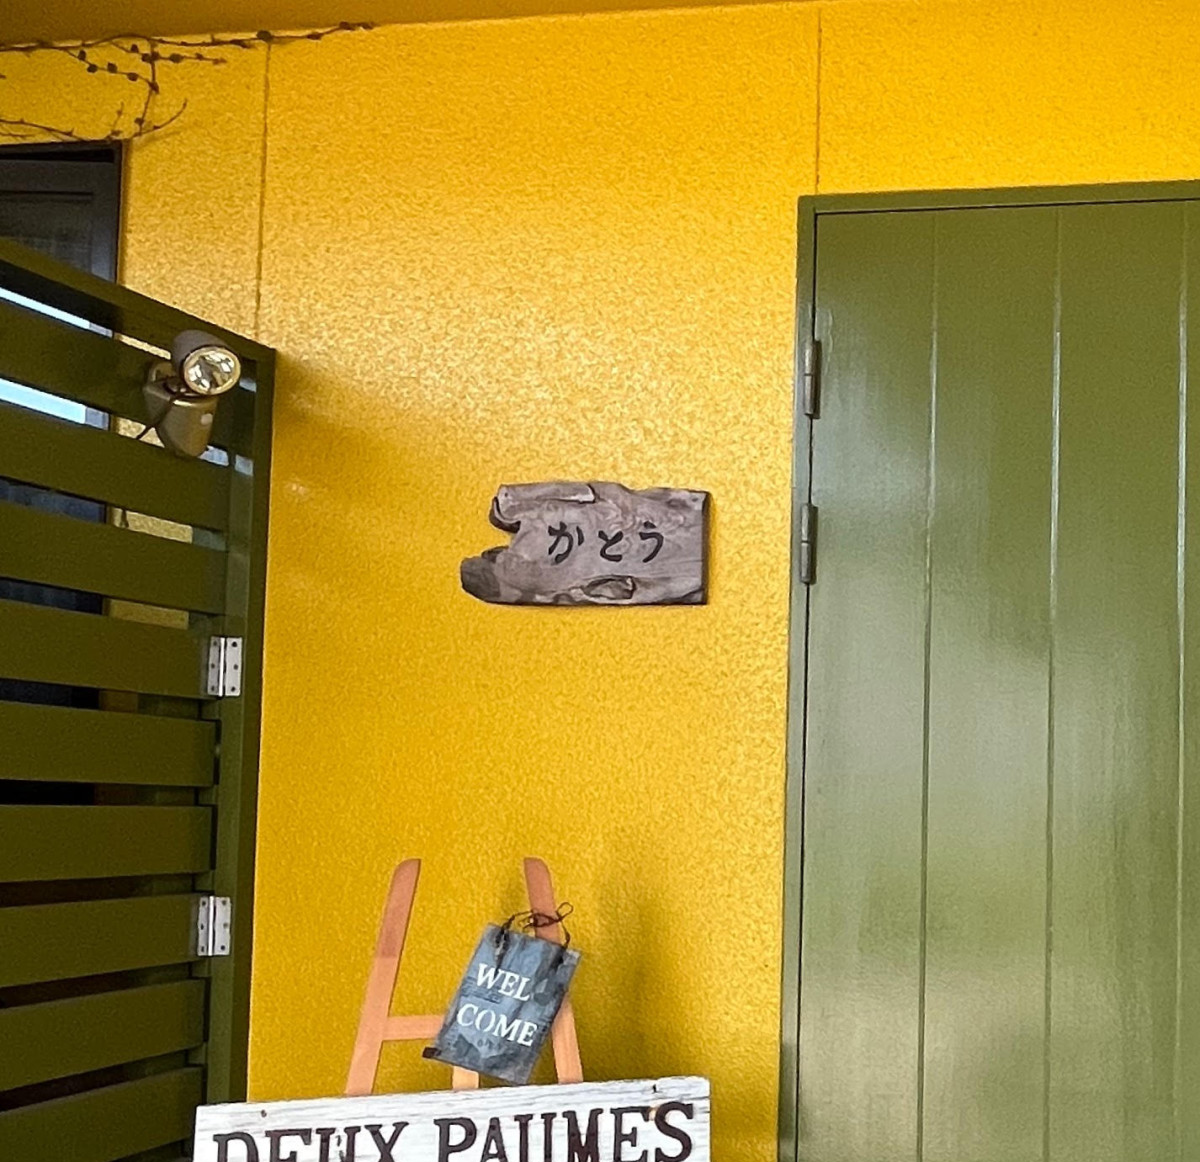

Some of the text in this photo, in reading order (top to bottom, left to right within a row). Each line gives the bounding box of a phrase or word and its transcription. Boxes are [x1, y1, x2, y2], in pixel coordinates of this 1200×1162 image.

[548, 521, 664, 563] かとう
[476, 962, 532, 1001] WEL
[457, 1003, 538, 1047] COME
